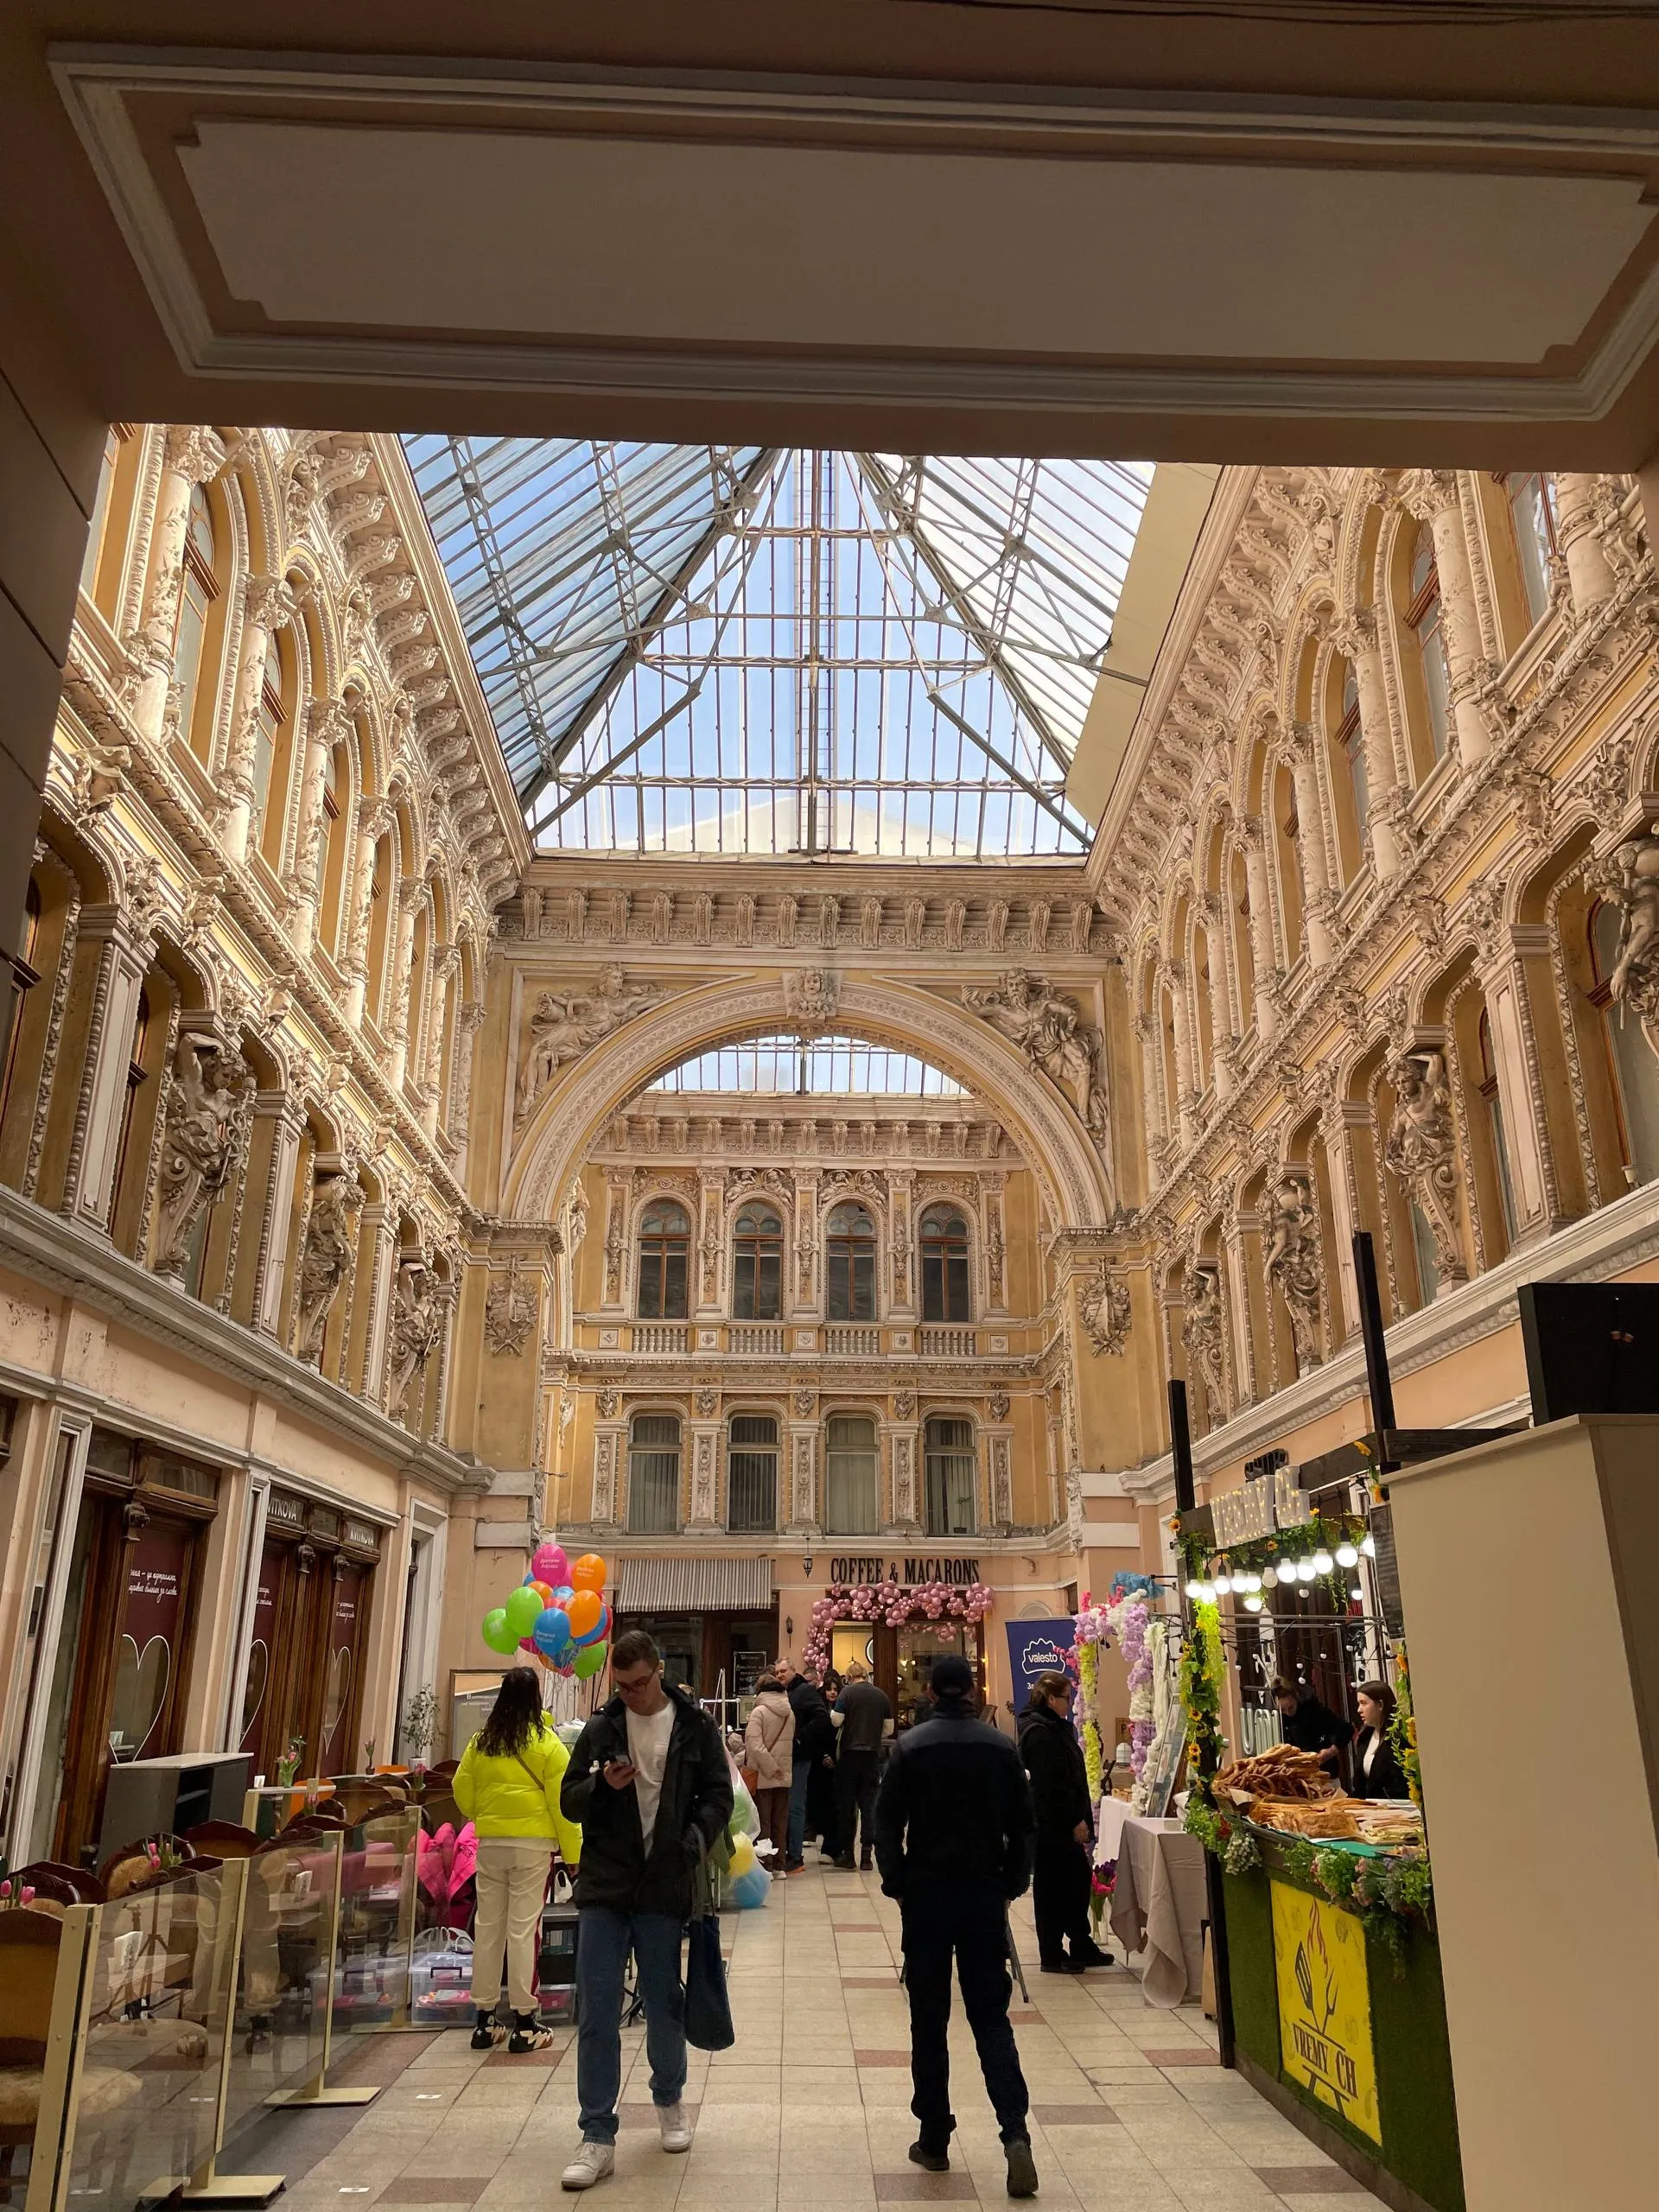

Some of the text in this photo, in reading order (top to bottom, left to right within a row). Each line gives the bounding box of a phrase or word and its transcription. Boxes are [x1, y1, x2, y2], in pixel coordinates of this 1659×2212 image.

[830, 1558, 980, 1585] COFFEE & MACARONS
[1028, 1652, 1058, 1663] valesto
[1293, 2023, 1359, 2101] VREMY CH
